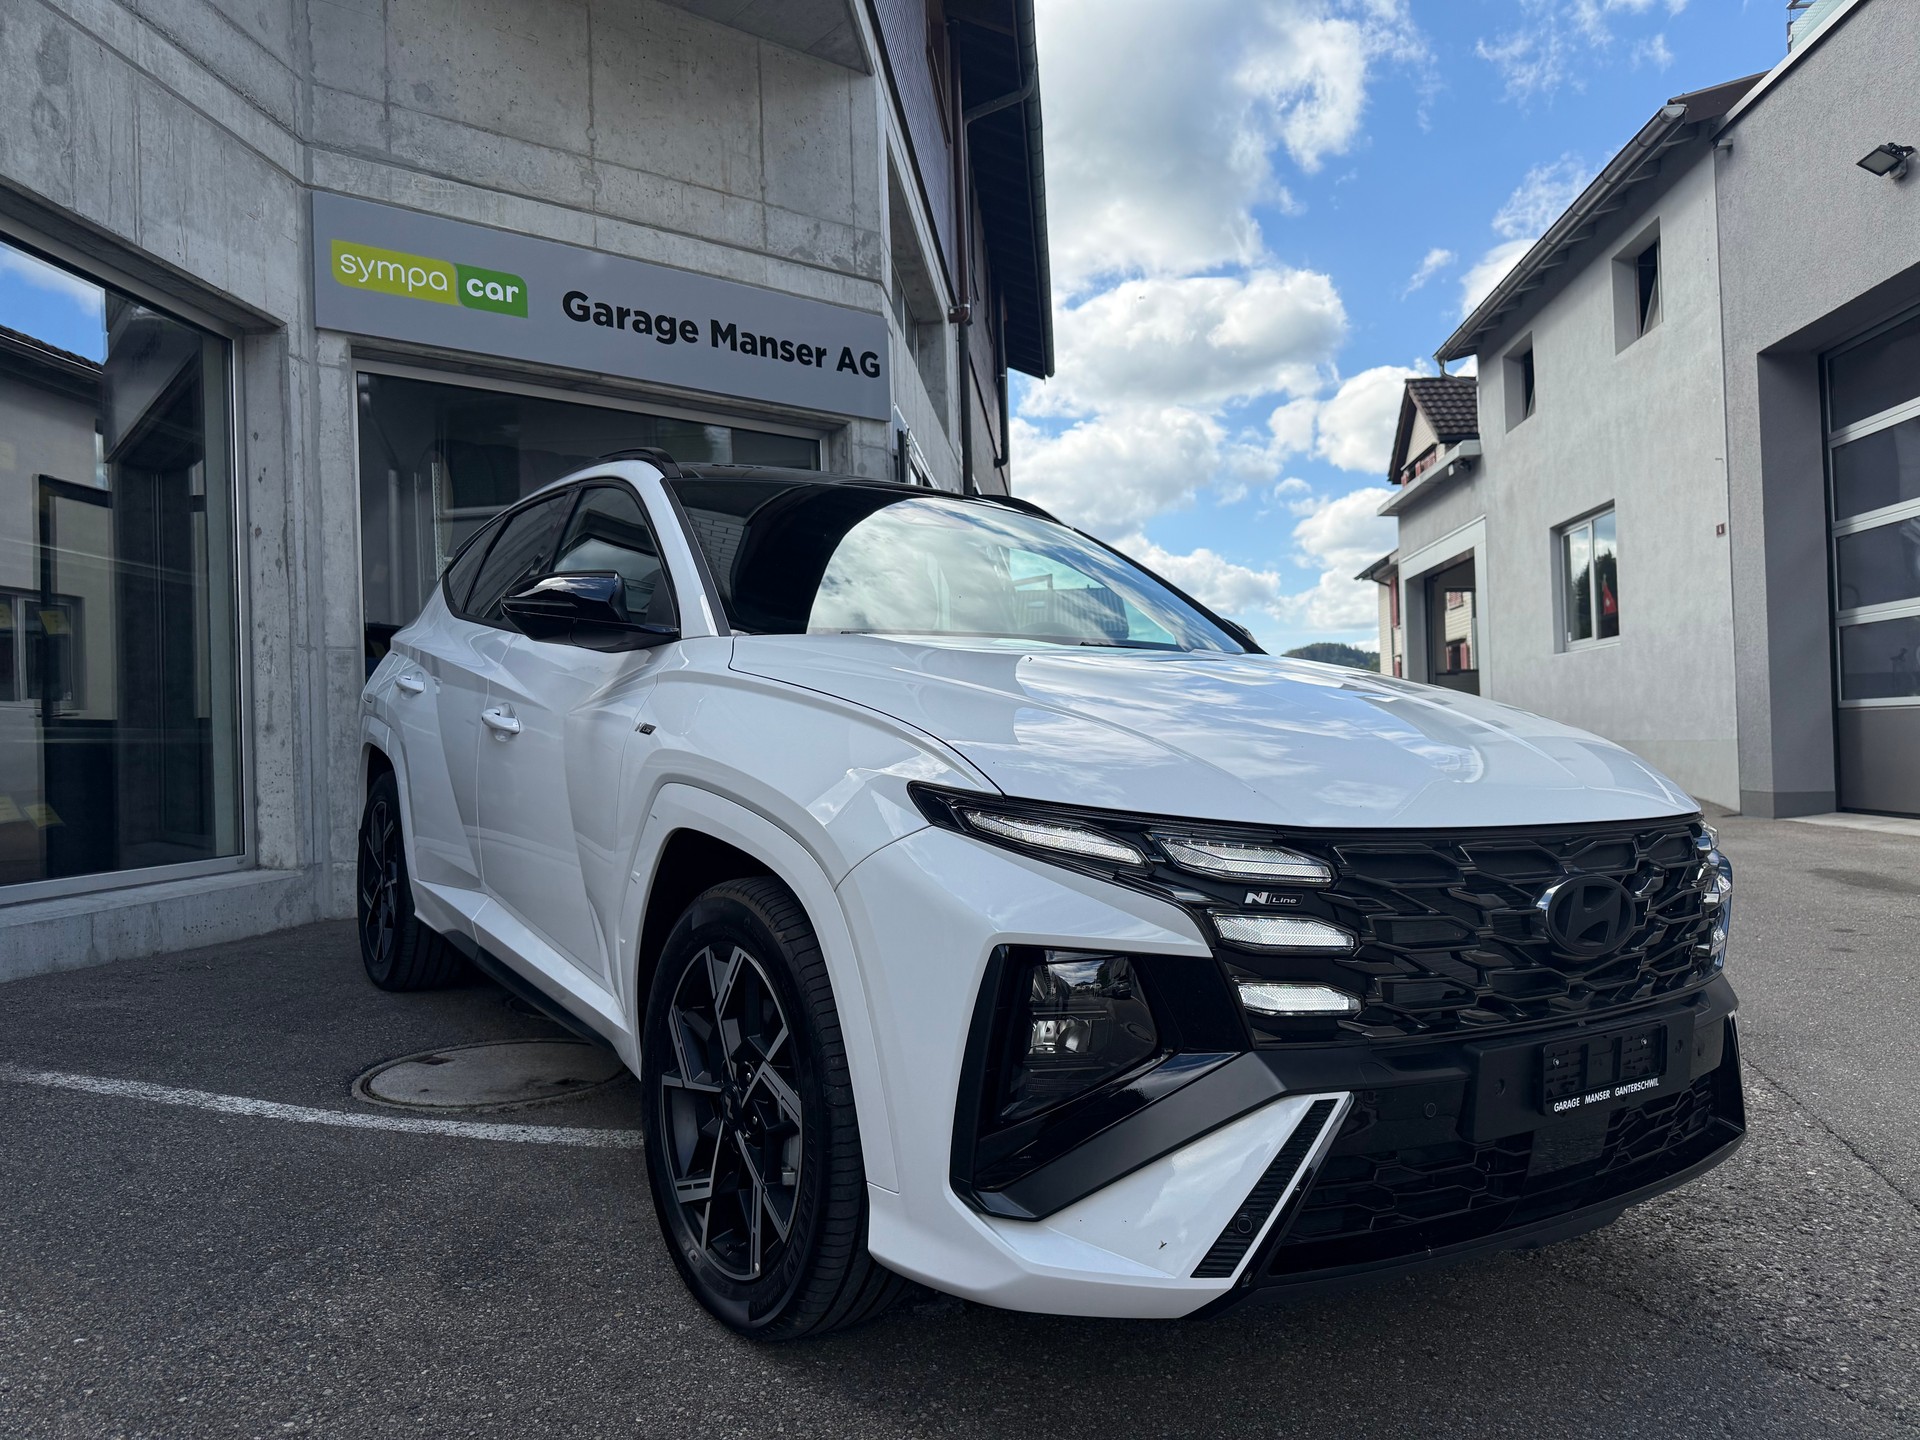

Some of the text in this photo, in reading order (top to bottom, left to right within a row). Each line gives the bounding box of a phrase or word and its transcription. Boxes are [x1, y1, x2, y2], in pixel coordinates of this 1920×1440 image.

[339, 253, 519, 303] sympa car
[562, 290, 881, 378] Garage Manser AG
[1244, 891, 1269, 905] N
[1553, 1077, 1660, 1113] GARAGE MANSER GANTERSCHWIL
